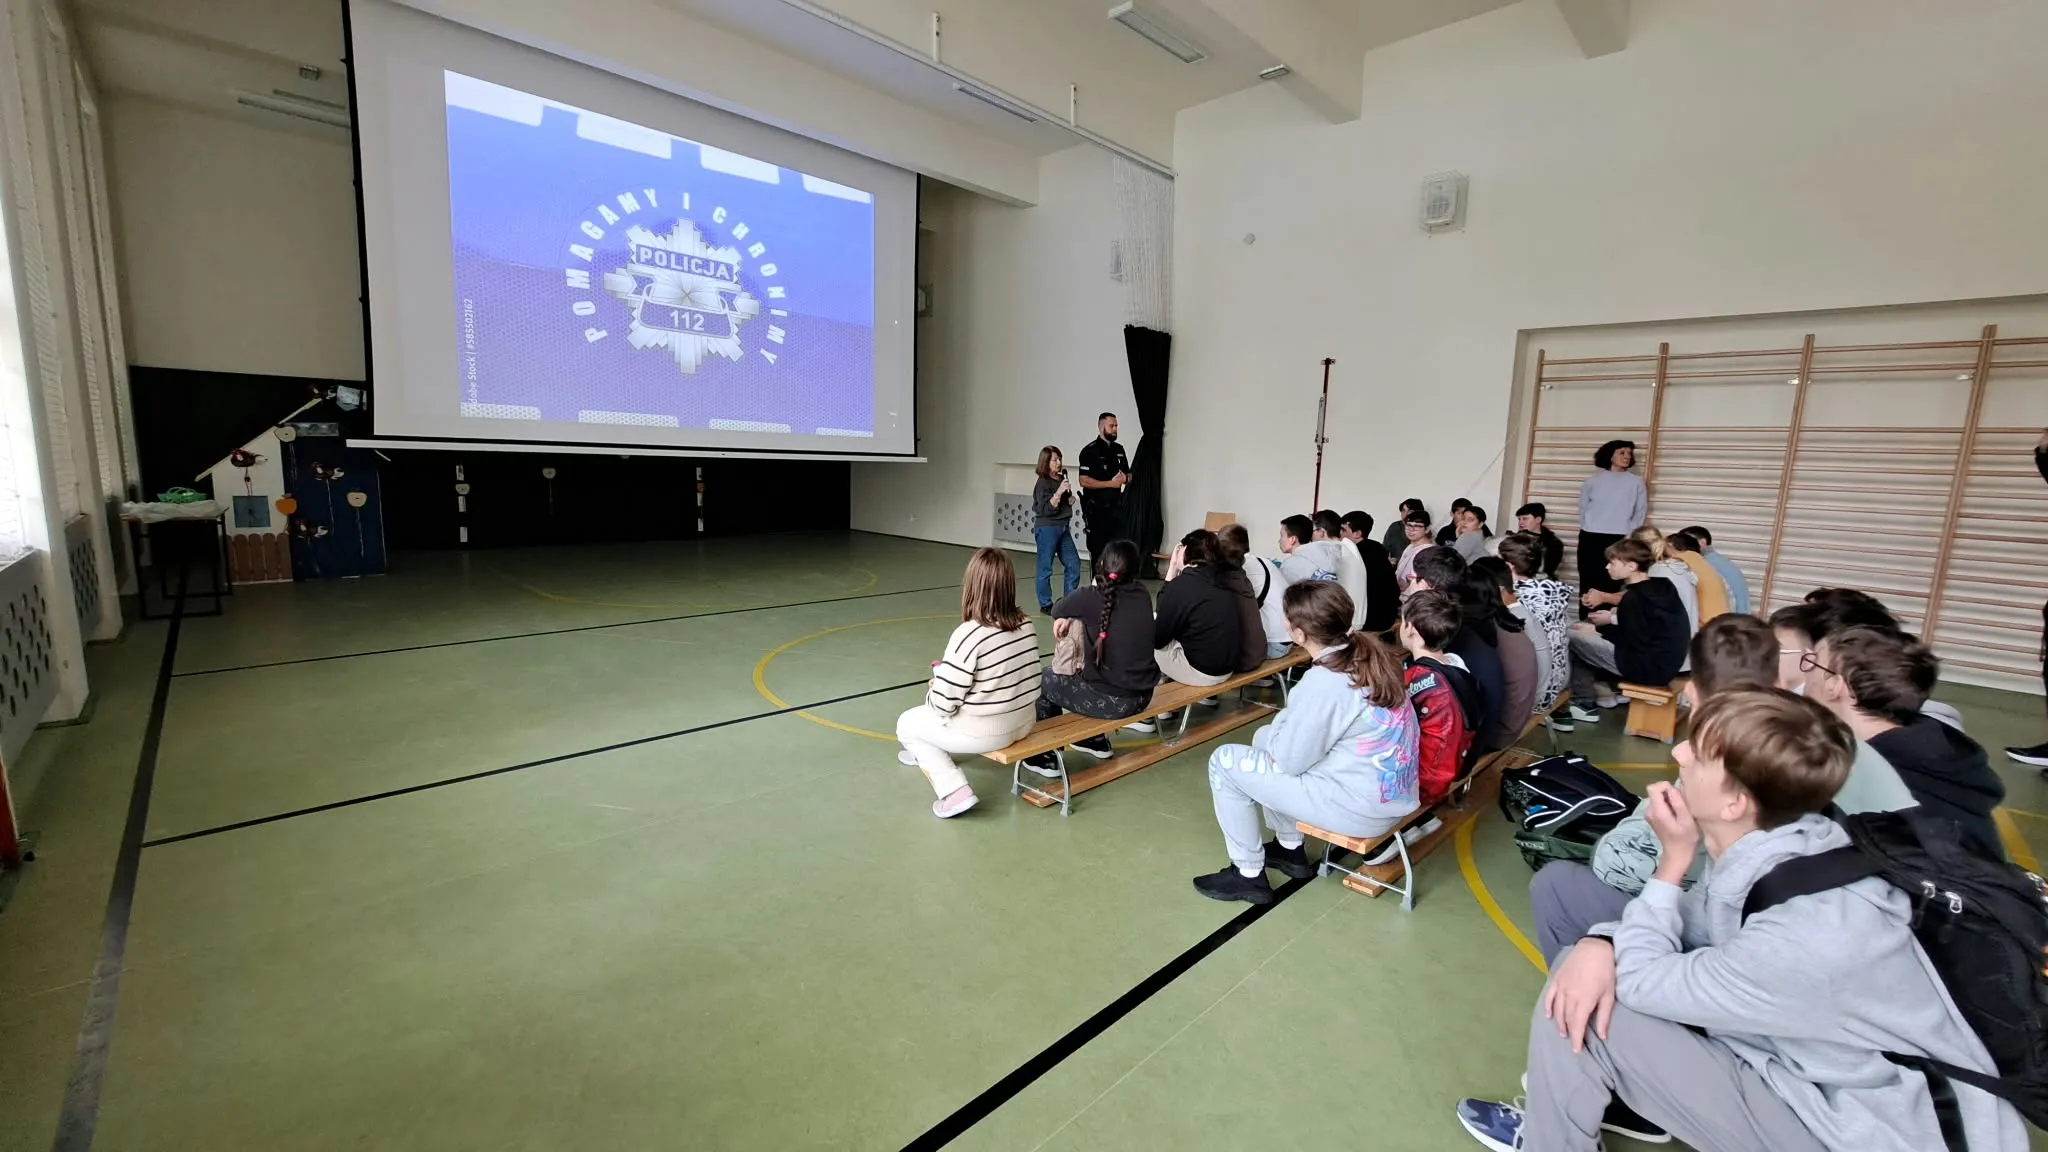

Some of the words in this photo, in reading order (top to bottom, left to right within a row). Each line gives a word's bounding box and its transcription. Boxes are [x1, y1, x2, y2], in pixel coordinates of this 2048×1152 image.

[565, 188, 659, 343] POMAGAMY
[683, 192, 690, 210] I
[712, 206, 788, 365] CHRONIMY
[639, 247, 730, 281] POLICJA
[670, 310, 705, 332] 112
[466, 356, 477, 380] Stock
